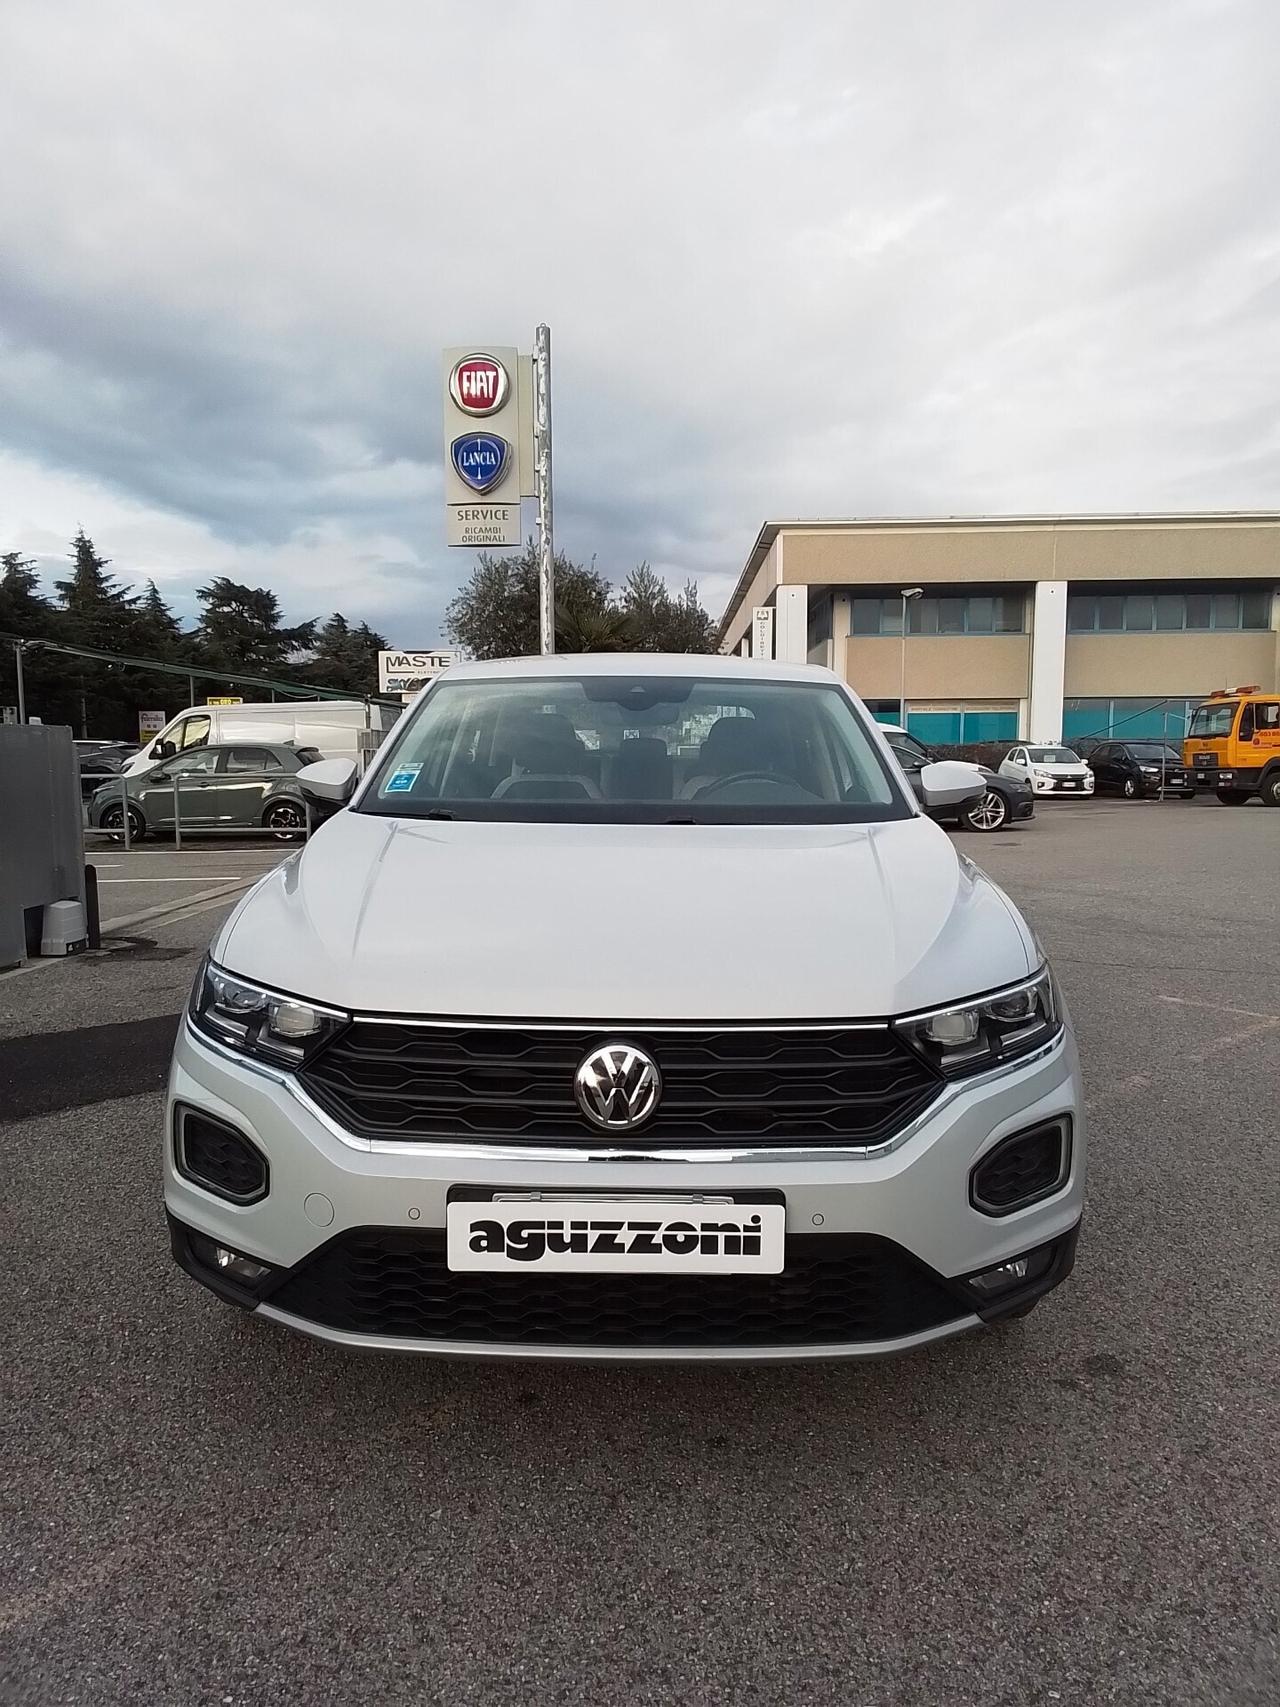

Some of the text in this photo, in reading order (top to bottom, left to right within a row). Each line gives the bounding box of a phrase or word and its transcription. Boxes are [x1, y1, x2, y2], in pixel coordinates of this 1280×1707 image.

[462, 371, 496, 399] FIAT
[463, 451, 496, 466] LANCIA
[457, 509, 509, 521] SERVICE
[464, 526, 502, 534] RICAMBI
[461, 534, 506, 543] ORIGINALI
[468, 1214, 762, 1262] aguzzoni
